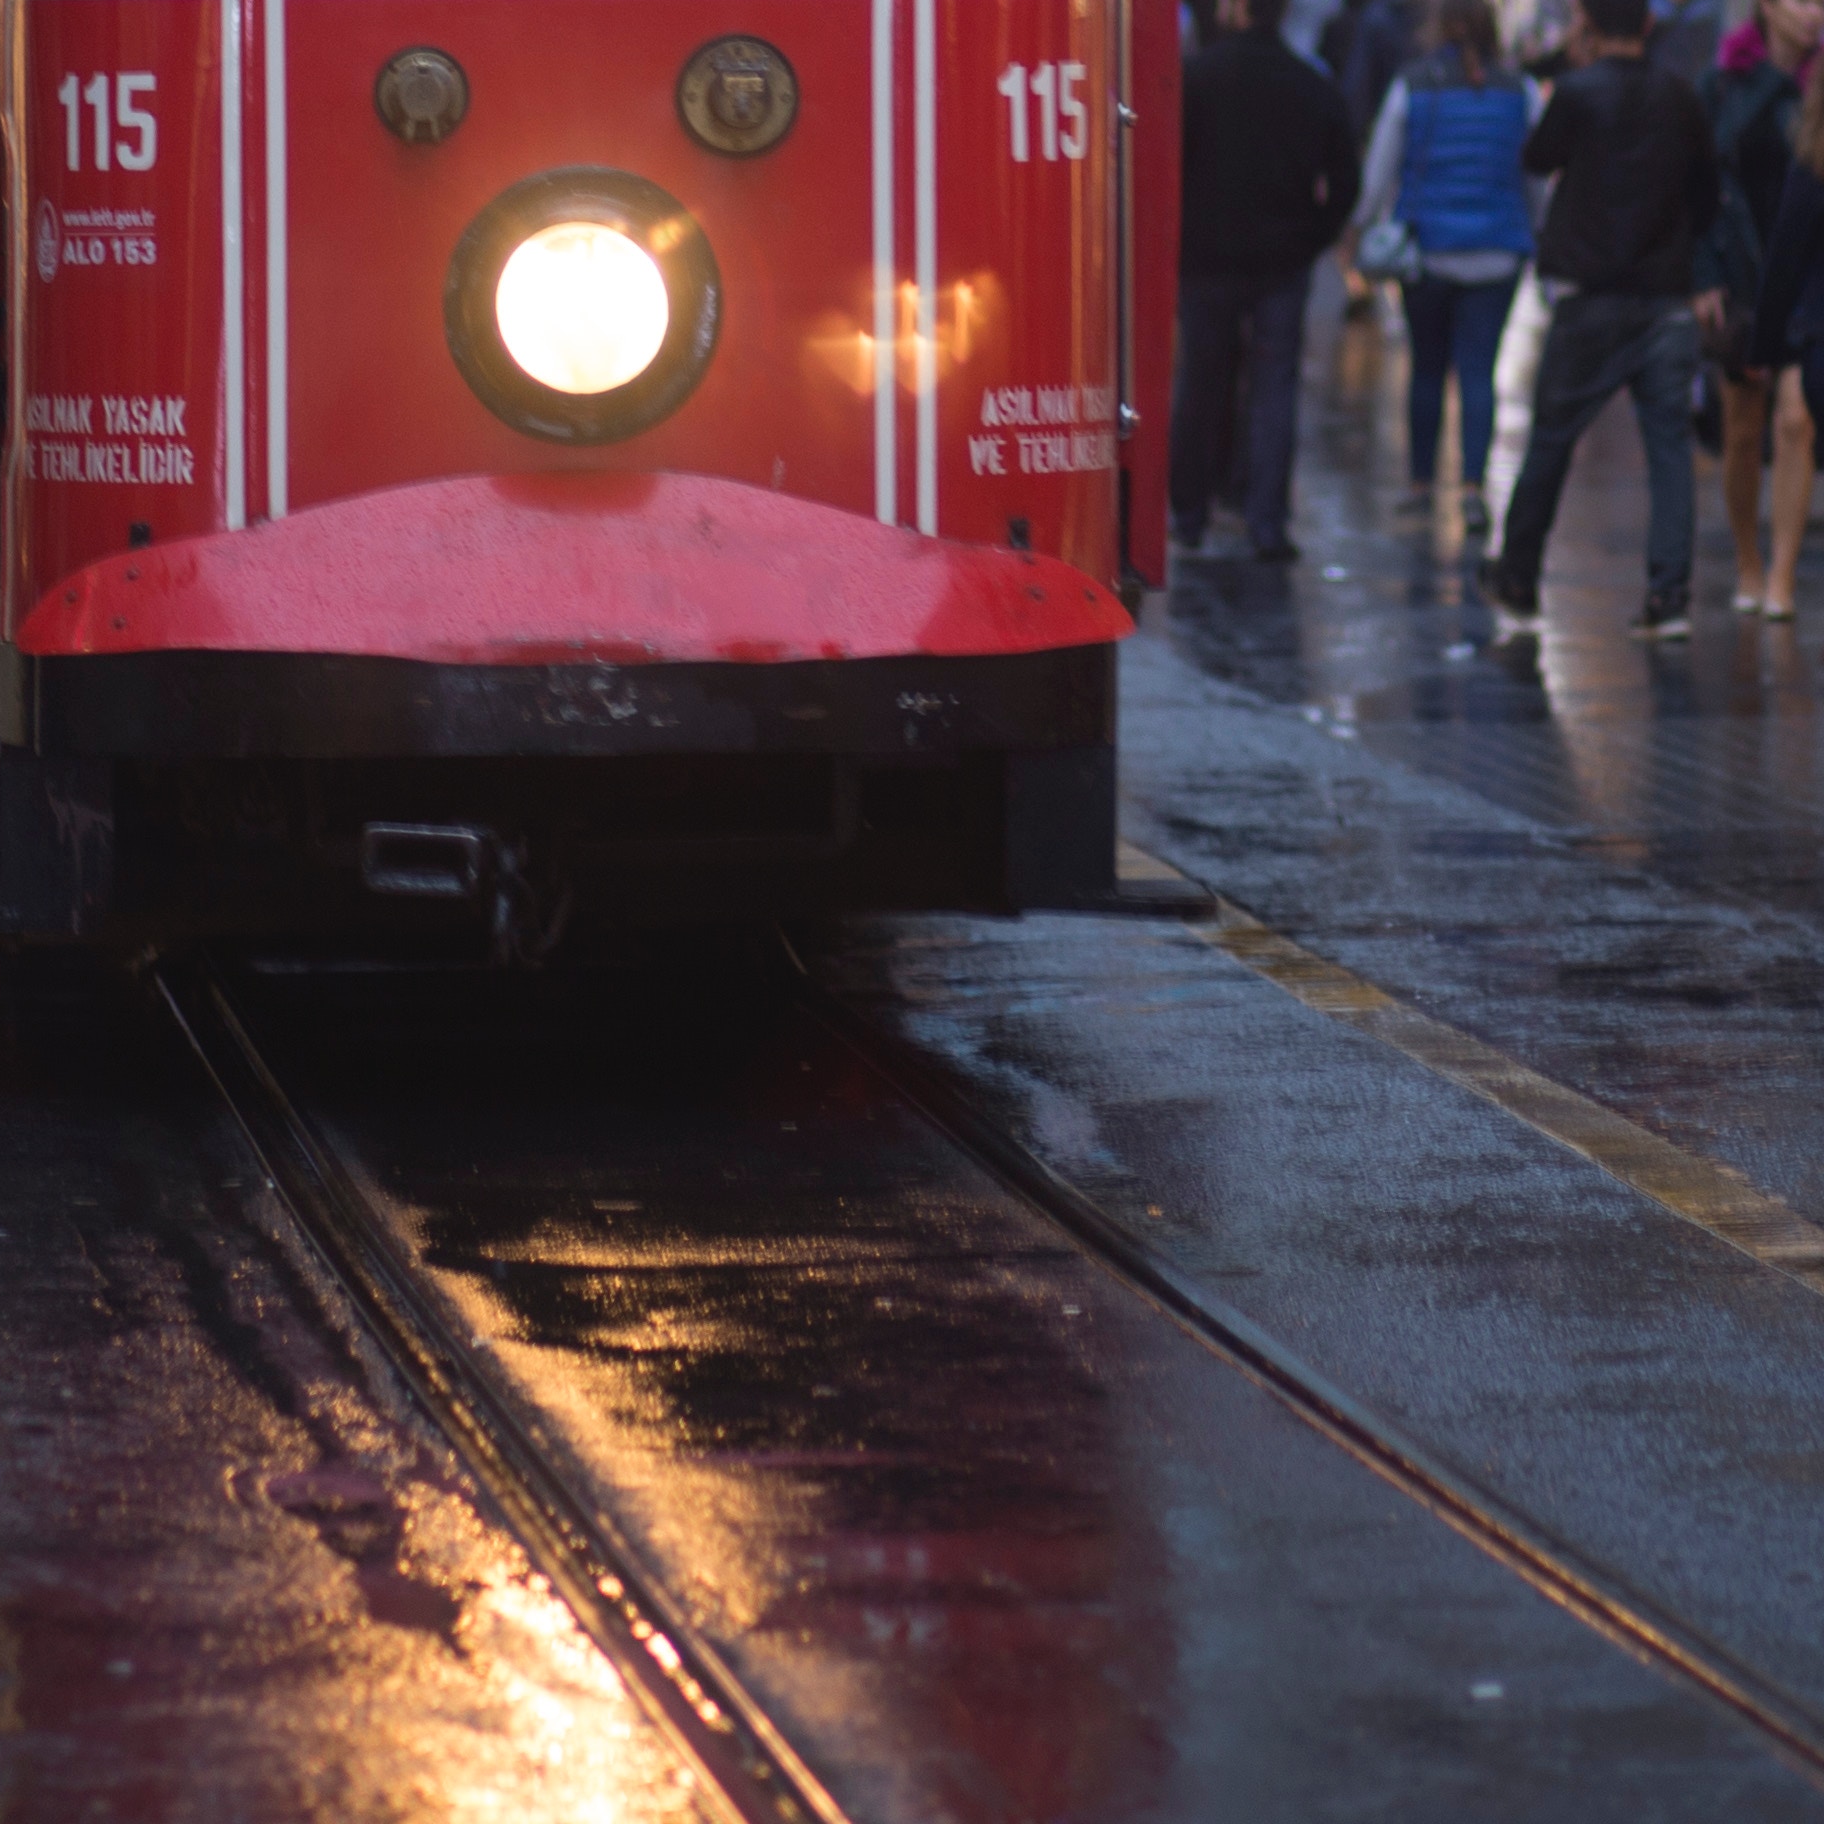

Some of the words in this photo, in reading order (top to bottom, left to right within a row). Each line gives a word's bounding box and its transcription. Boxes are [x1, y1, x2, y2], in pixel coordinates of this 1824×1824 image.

[57, 70, 158, 174] 115
[998, 59, 1088, 163] 115
[63, 236, 107, 266] ALO
[111, 236, 158, 266] 153
[102, 394, 187, 437] YASAK
